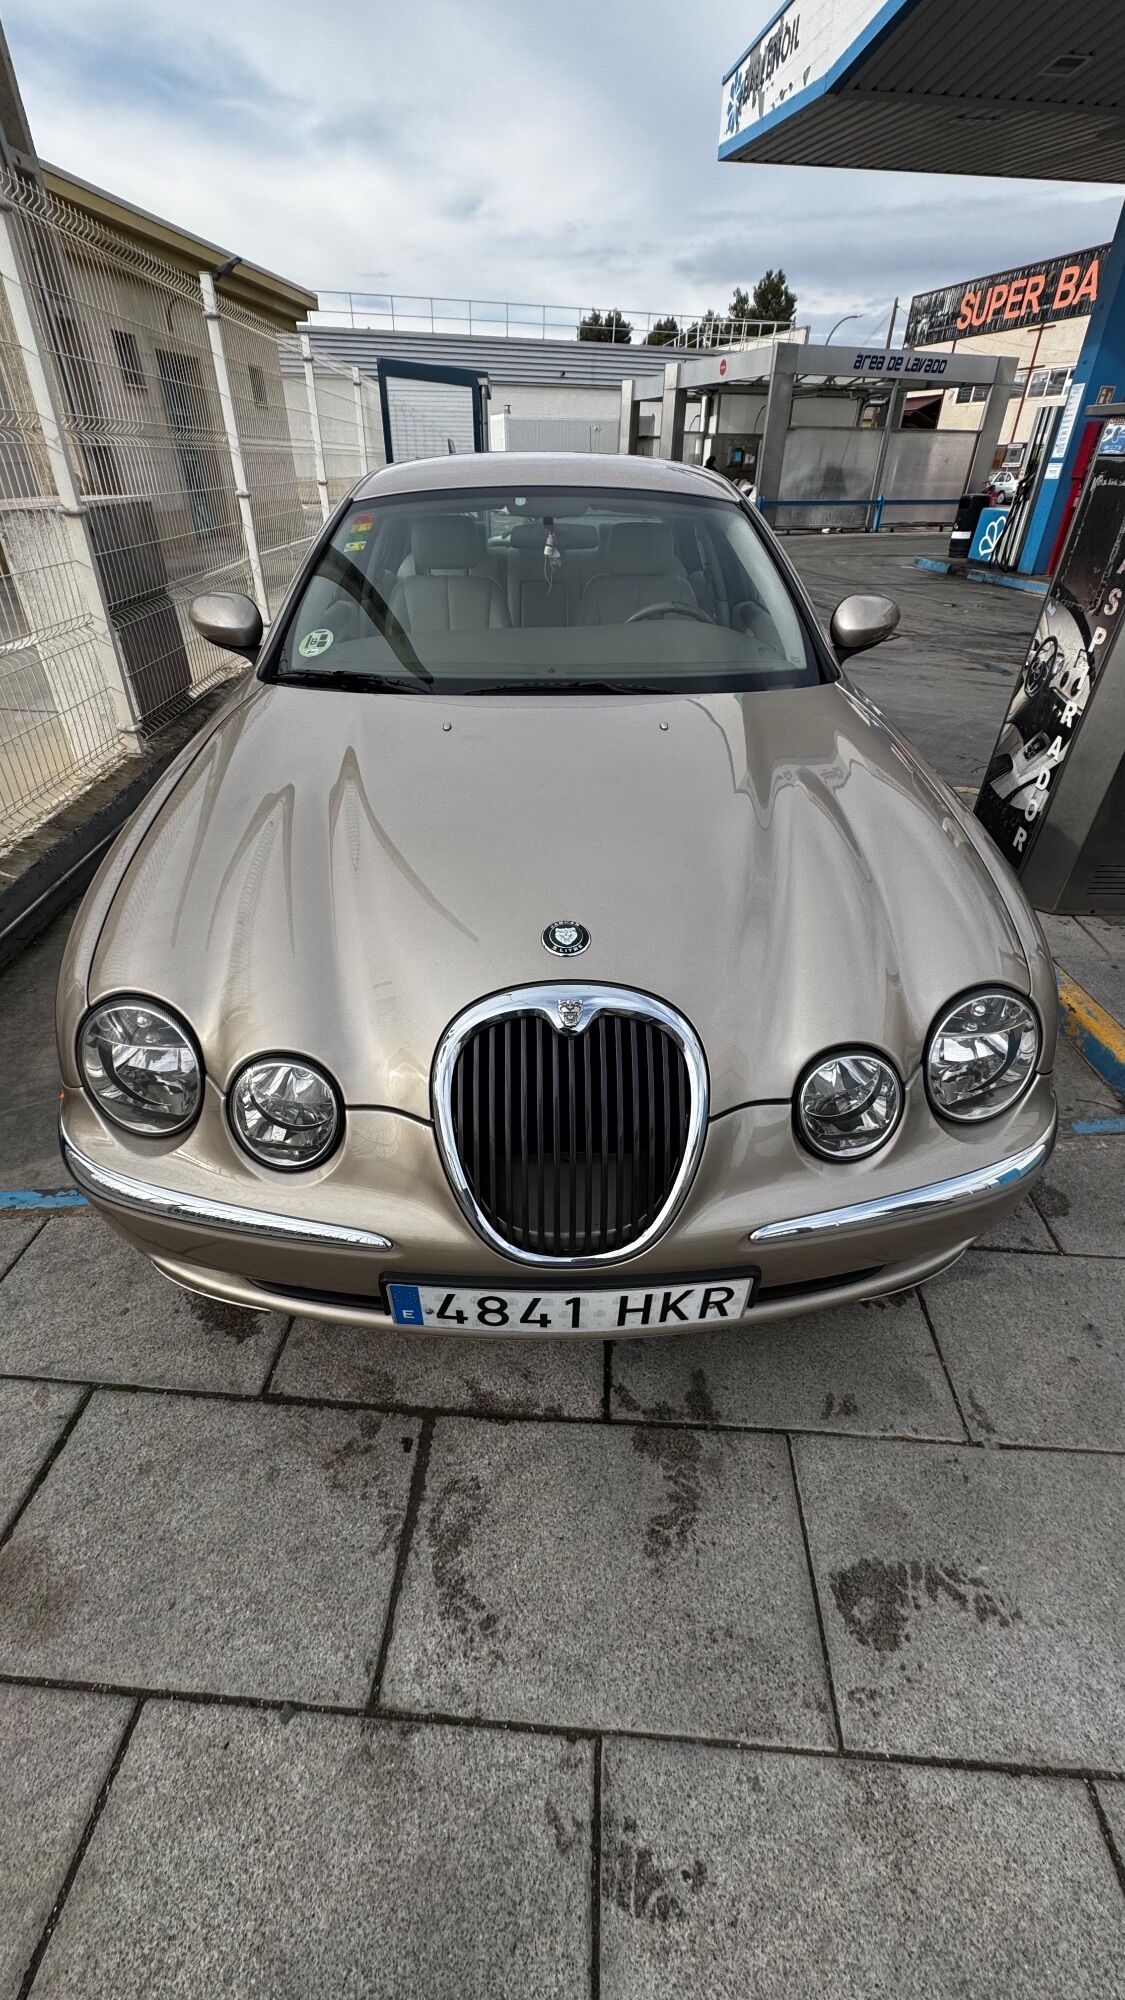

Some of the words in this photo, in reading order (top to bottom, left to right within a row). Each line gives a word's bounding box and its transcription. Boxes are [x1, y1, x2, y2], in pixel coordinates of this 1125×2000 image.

[956, 274, 1046, 331] SUPER
[560, 944, 583, 952] LITRE
[402, 1309, 415, 1319] E
[436, 1293, 582, 1329] 4841
[616, 1286, 736, 1327] HKR
